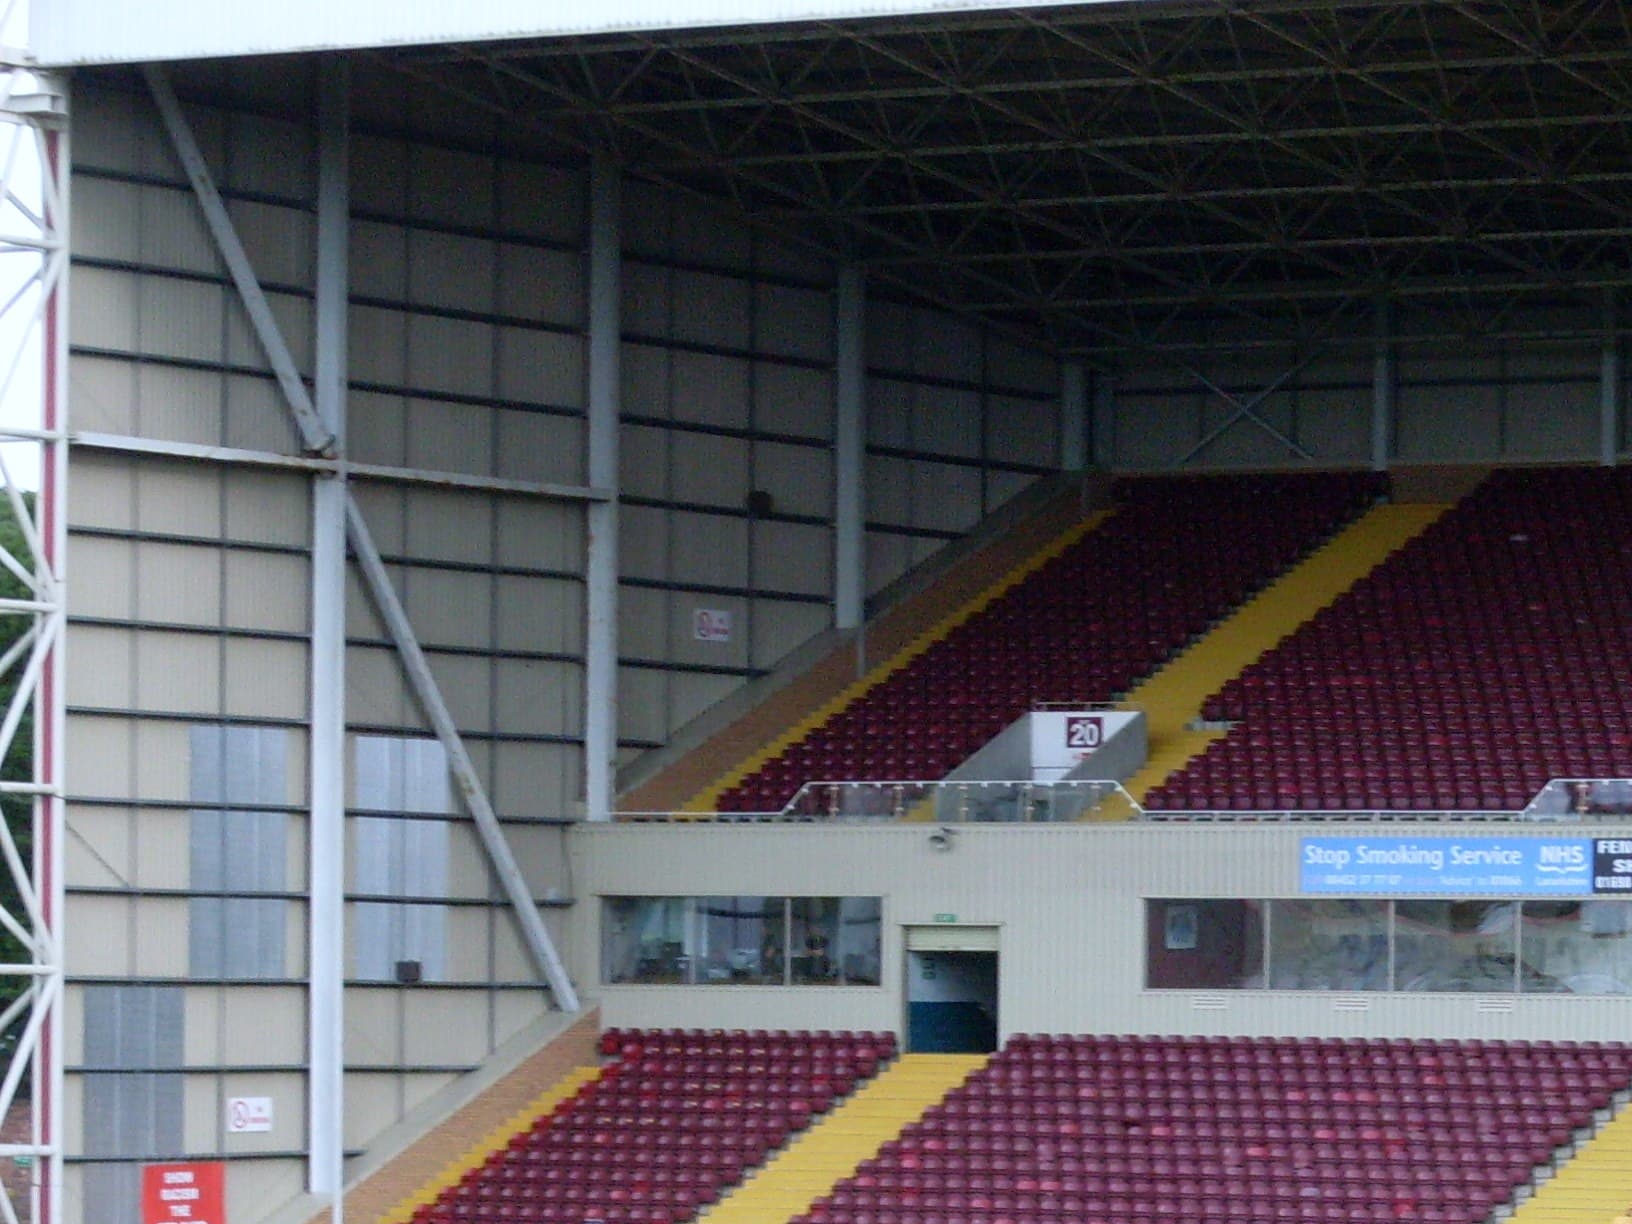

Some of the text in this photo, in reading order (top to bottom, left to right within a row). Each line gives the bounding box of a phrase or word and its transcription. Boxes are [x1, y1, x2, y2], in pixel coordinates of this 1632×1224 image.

[1069, 723, 1100, 746] 20
[1304, 844, 1523, 871] Stop Smoking Service
[1540, 845, 1585, 865] NHS
